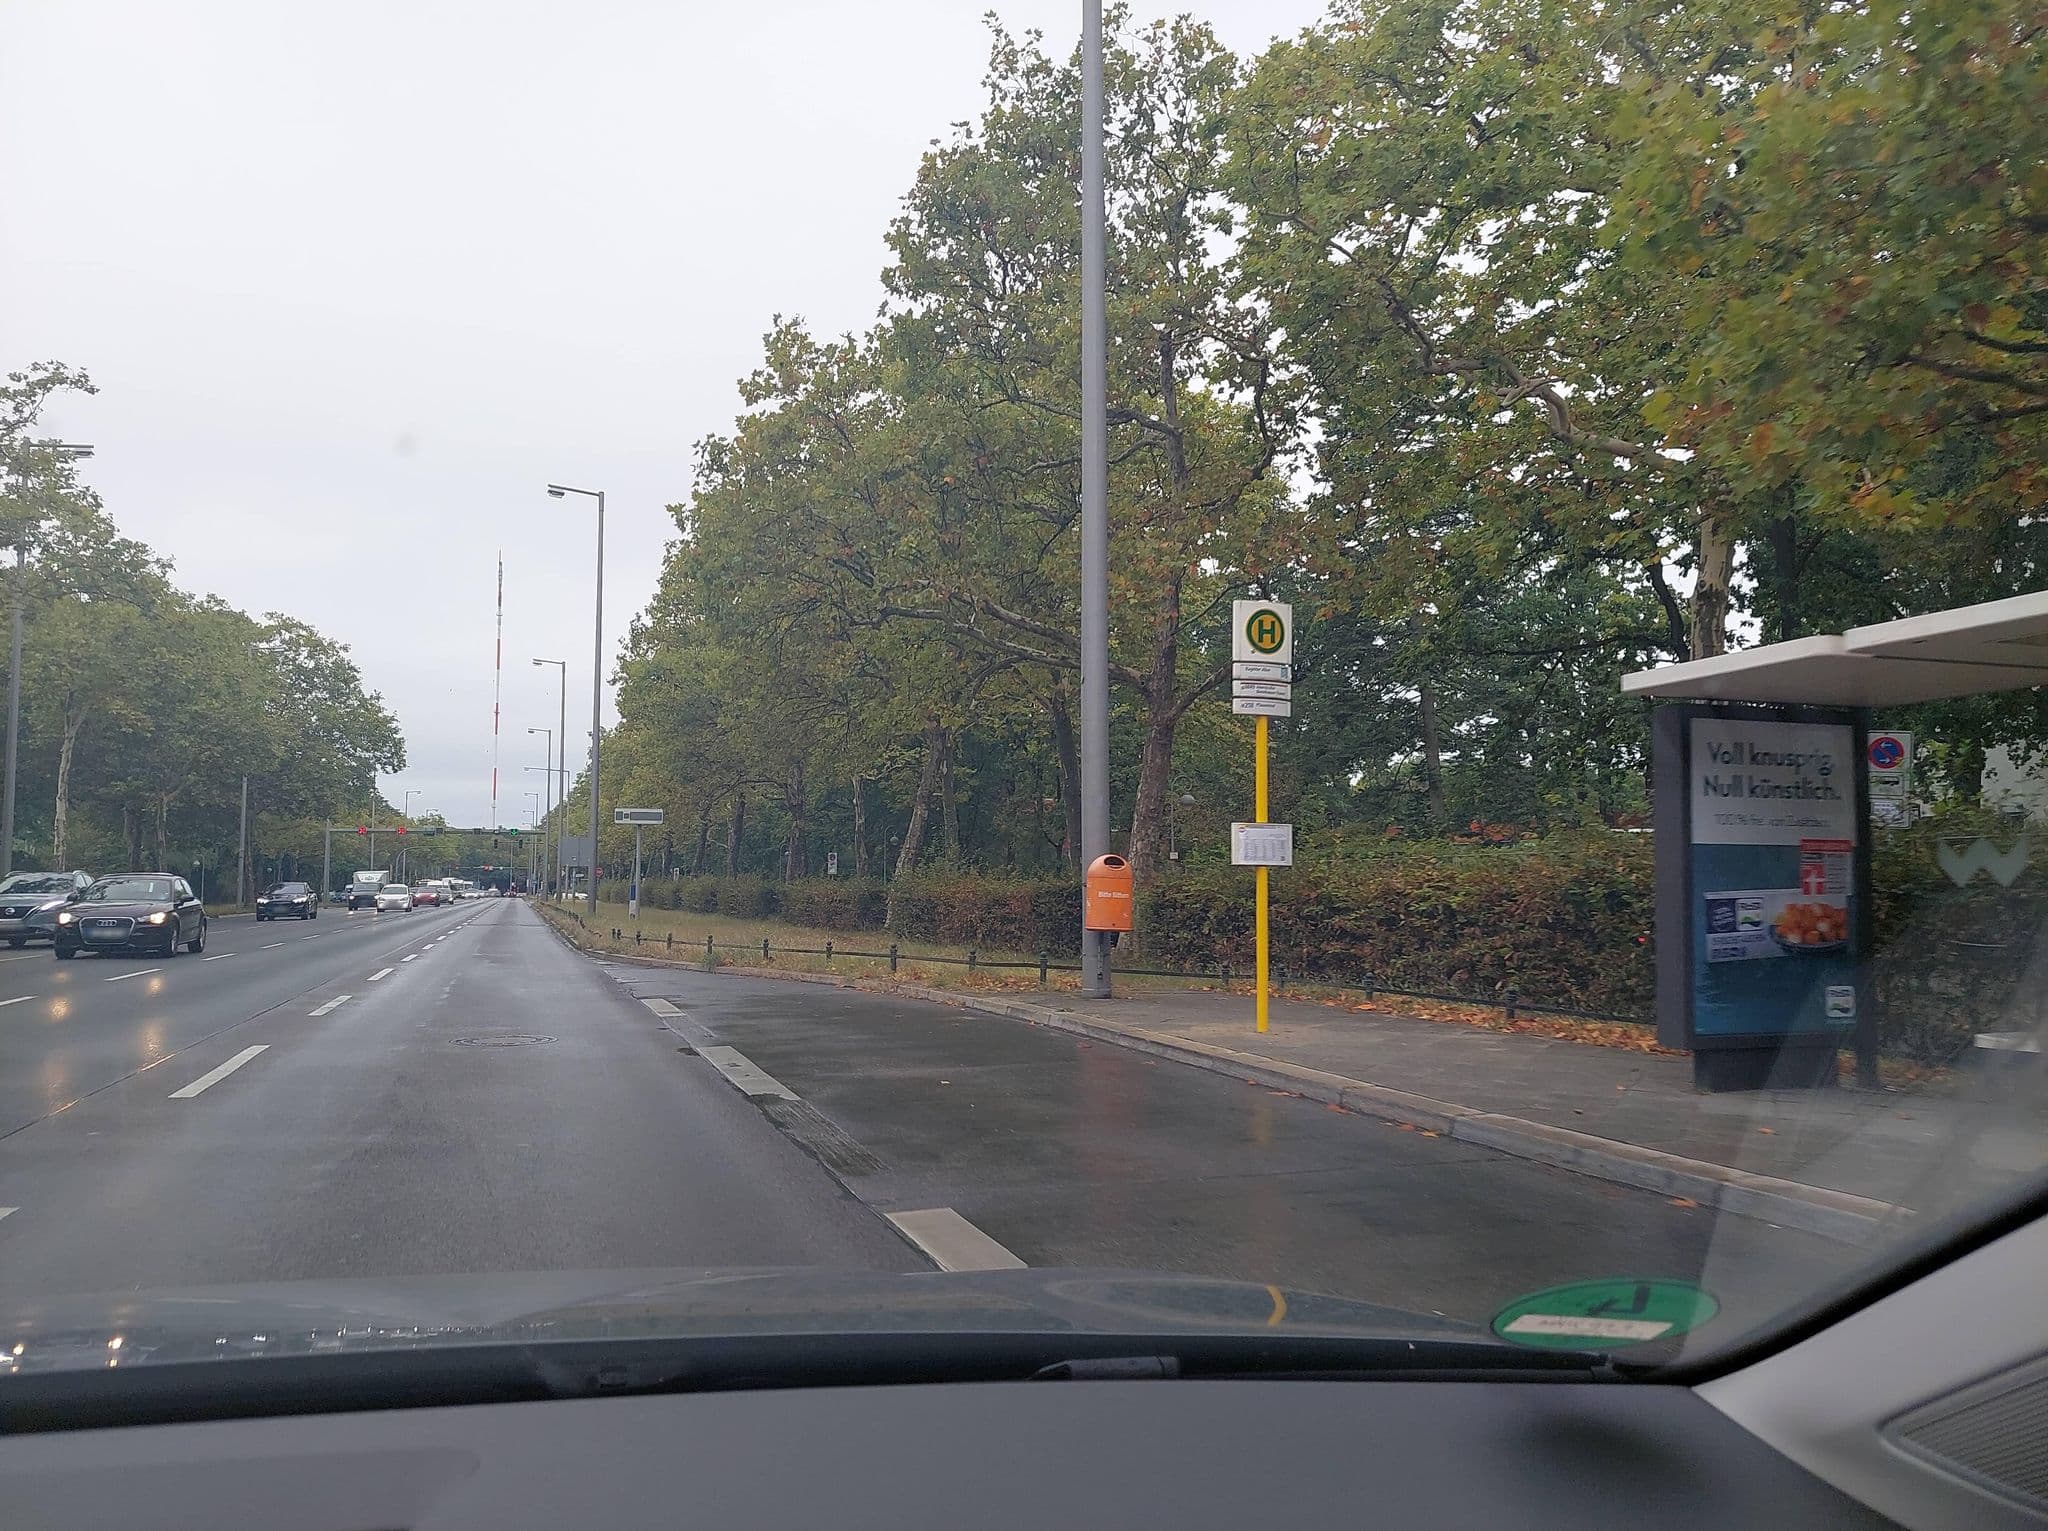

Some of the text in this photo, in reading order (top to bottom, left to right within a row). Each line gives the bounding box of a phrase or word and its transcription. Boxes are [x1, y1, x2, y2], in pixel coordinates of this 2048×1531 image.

[1257, 619, 1276, 644] H
[1706, 741, 1744, 764] Voll
[1703, 774, 1744, 798] Null
